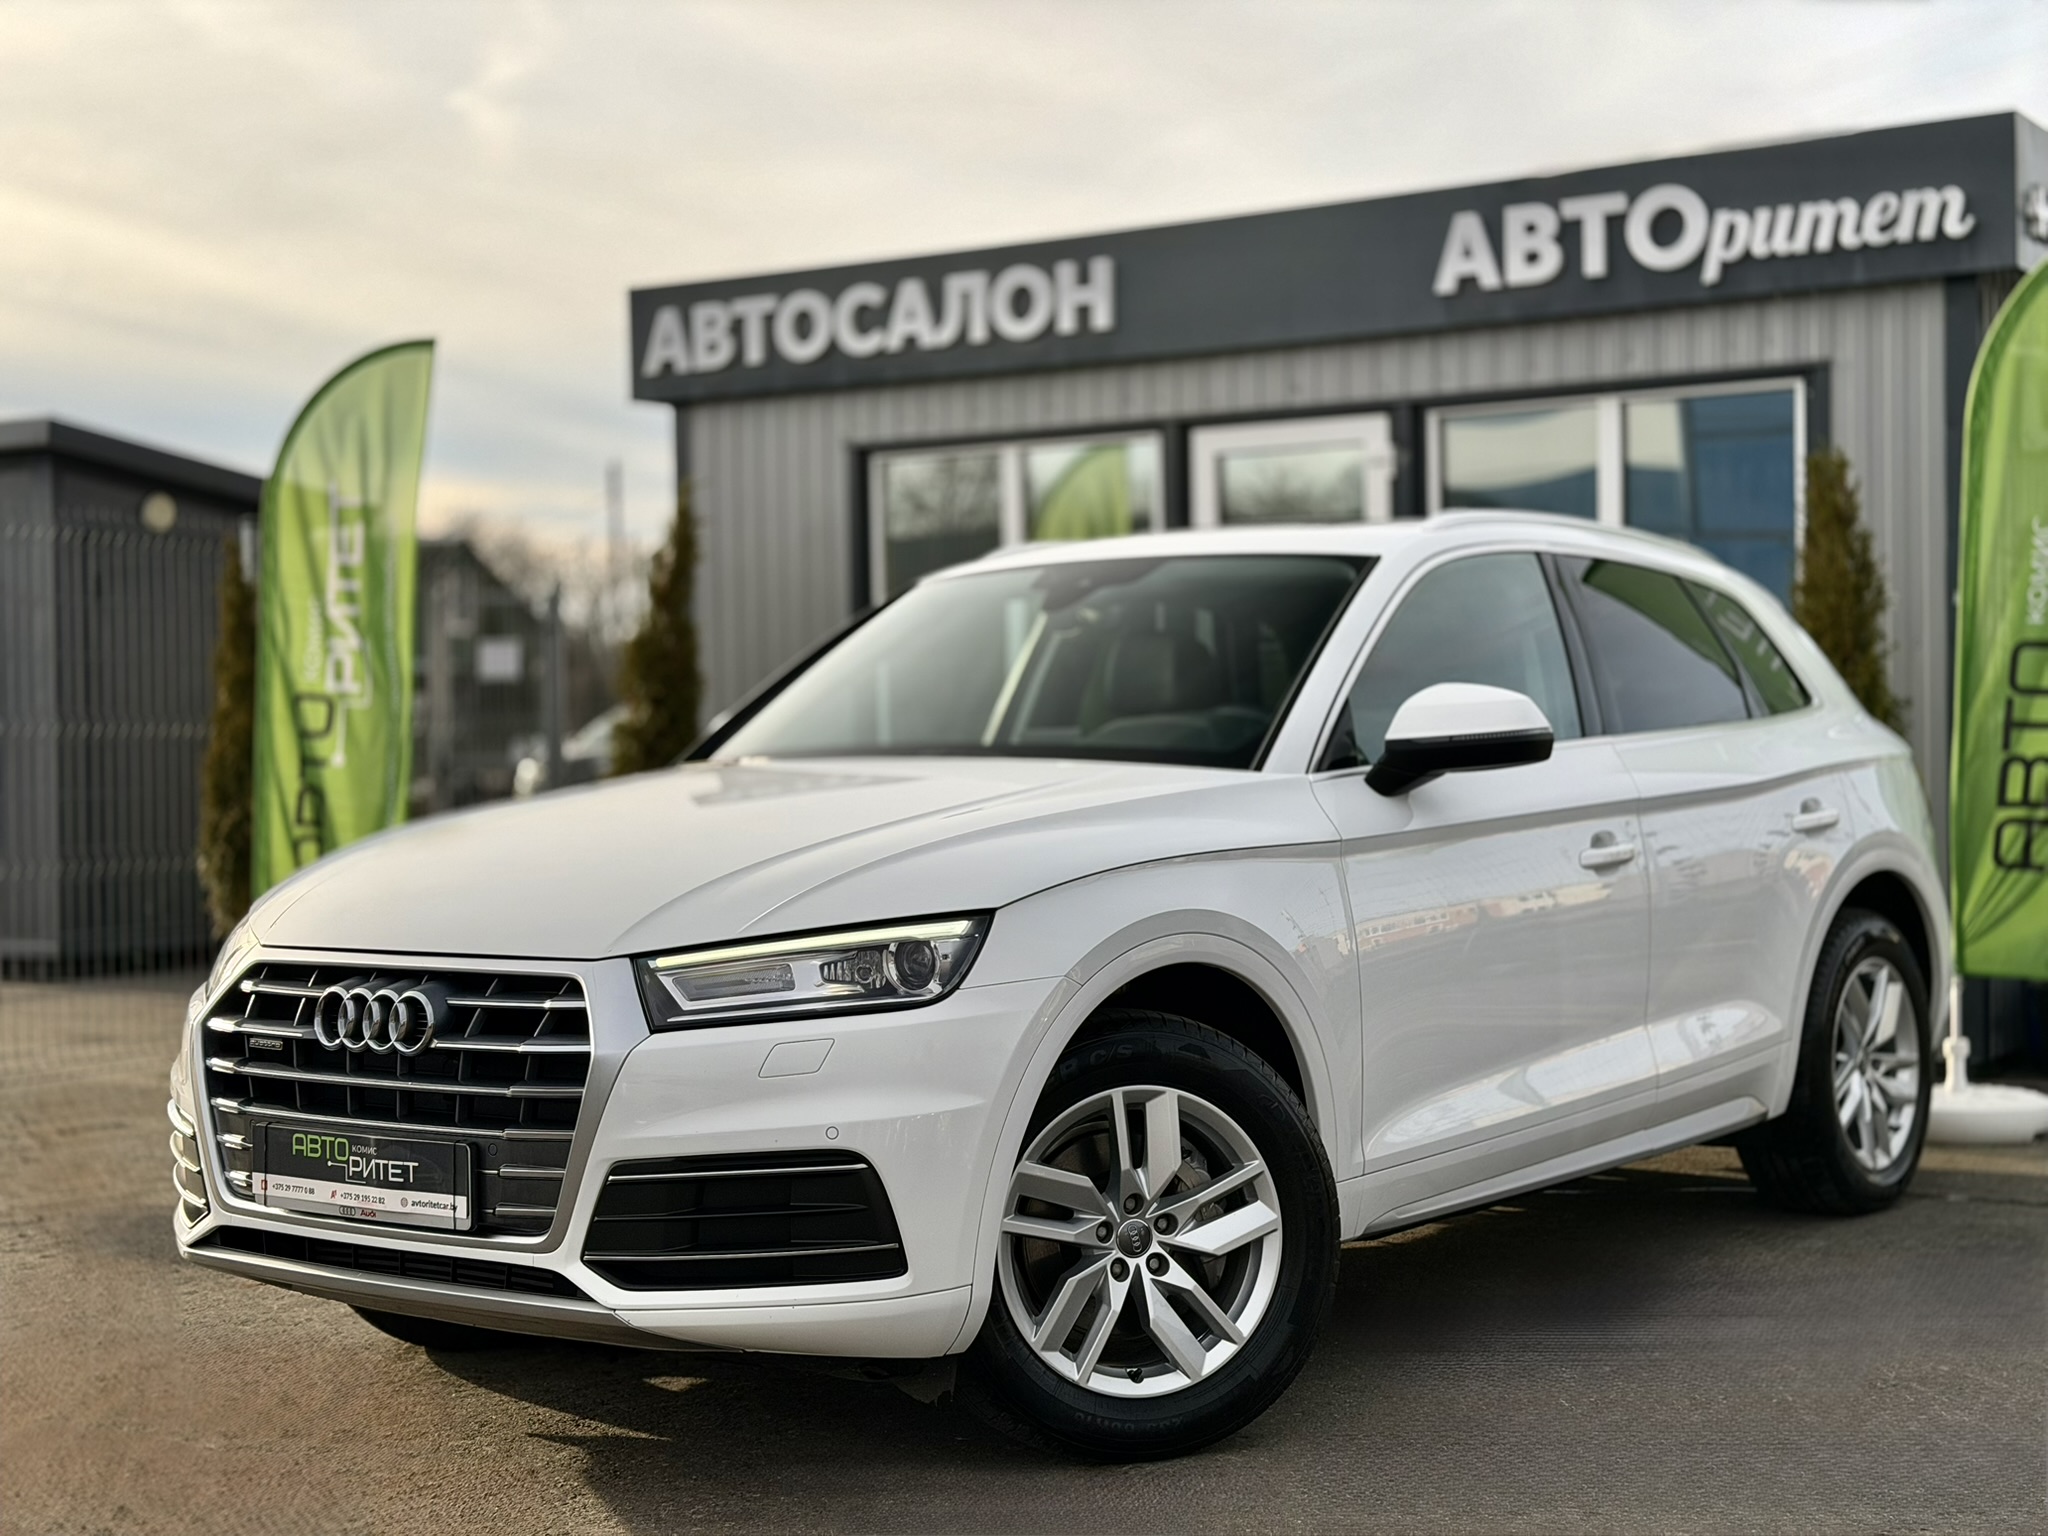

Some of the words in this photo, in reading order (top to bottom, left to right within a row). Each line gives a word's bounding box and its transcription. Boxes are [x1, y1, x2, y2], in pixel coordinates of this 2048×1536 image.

[642, 255, 1115, 378] АВТОСАЛОН
[292, 1133, 349, 1161] АВТО
[349, 1155, 419, 1183] РИТЕТ
[340, 1192, 352, 1200] +375
[360, 1210, 377, 1218] Audi
